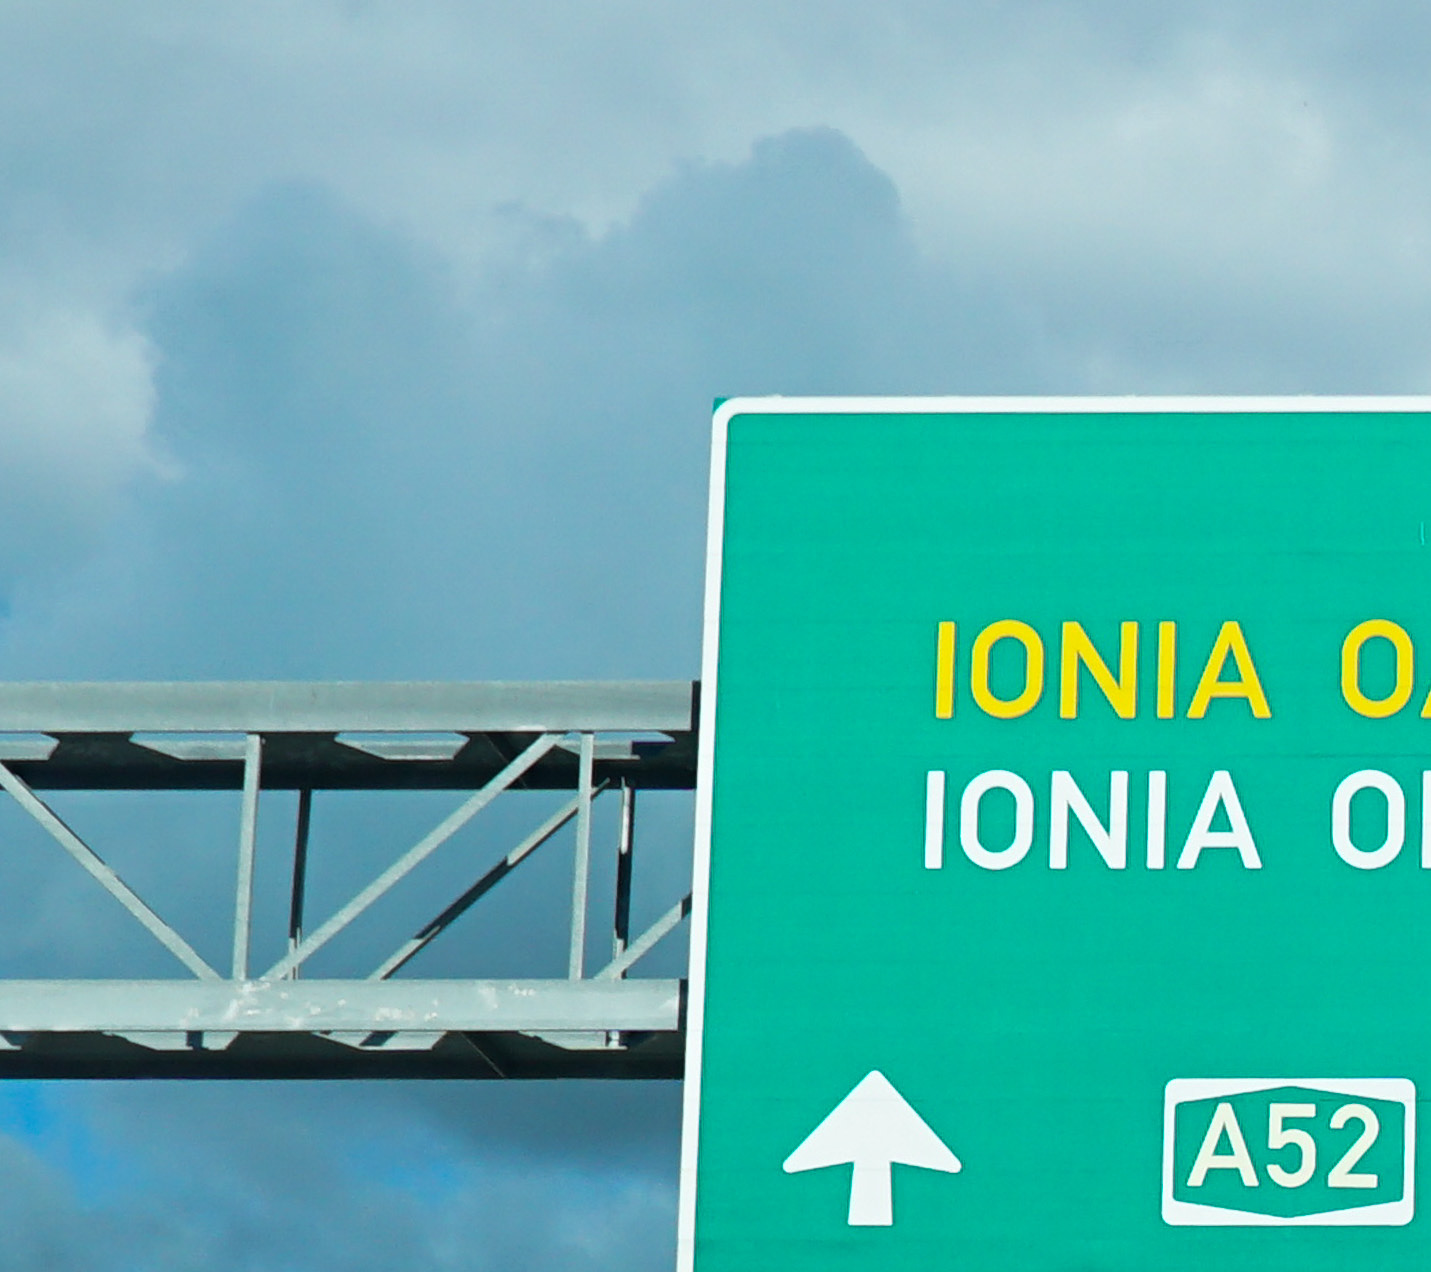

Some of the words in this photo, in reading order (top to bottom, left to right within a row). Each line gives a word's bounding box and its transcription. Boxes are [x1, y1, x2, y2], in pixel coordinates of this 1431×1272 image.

[935, 619, 1273, 719] ΙΟΝΙΑ
[924, 769, 1263, 871] IONIA
[1186, 1102, 1380, 1189] A52
